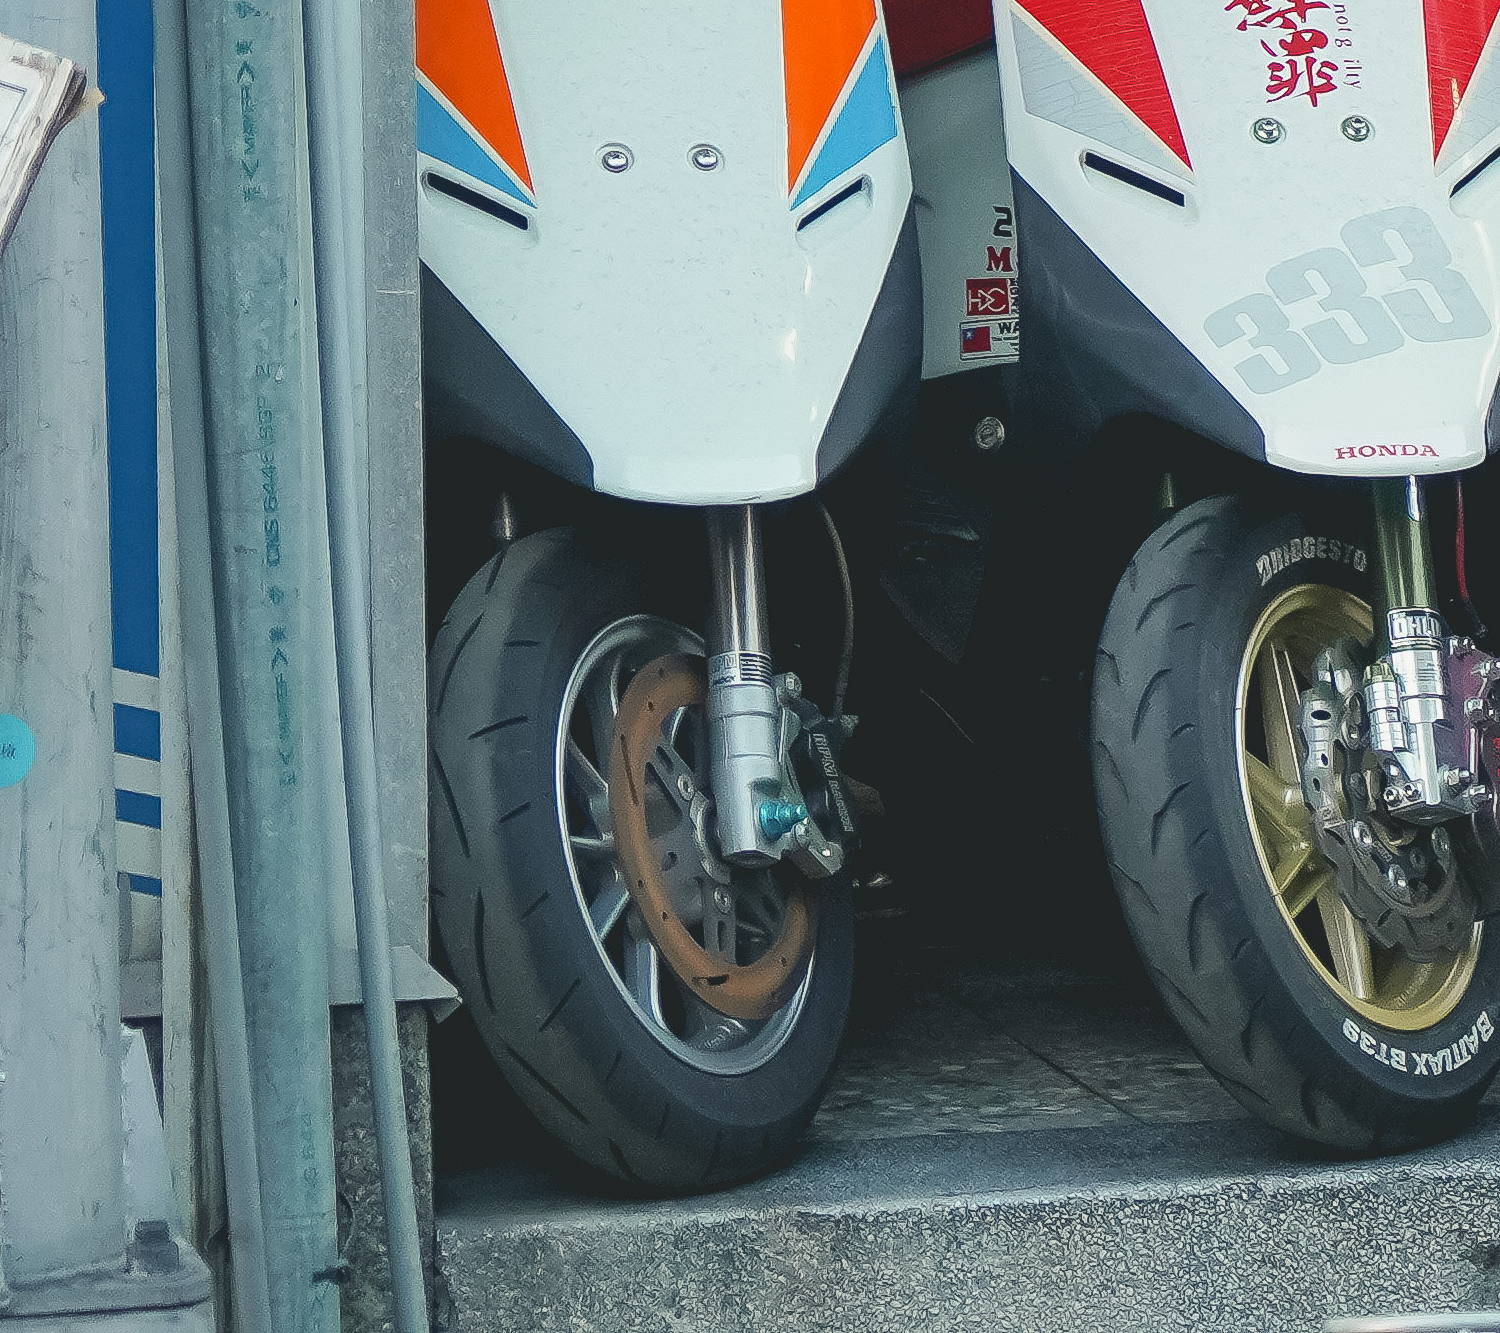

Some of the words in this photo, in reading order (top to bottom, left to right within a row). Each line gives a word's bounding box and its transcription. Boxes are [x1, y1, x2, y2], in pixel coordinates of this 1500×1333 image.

[1203, 206, 1493, 395] 333
[1334, 442, 1441, 461] HONDA
[1255, 535, 1368, 587] BRIDGESTO
